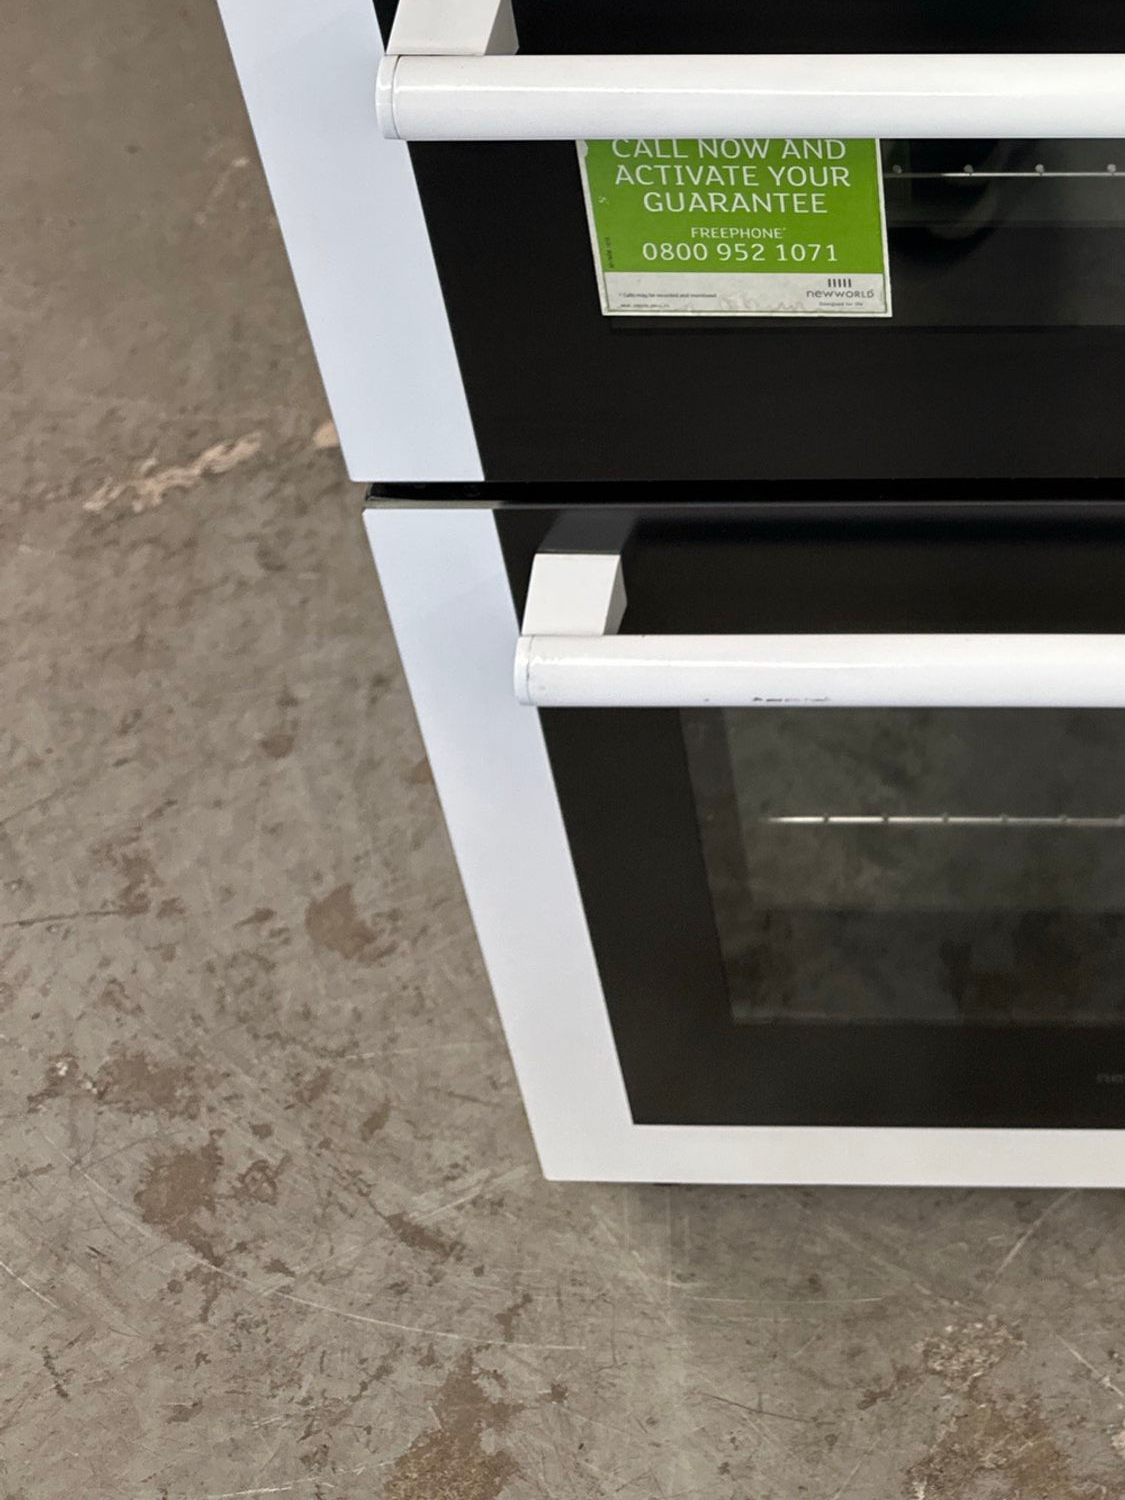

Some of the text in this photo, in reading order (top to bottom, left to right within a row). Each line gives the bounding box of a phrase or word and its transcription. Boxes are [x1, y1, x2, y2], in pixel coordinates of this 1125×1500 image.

[611, 138, 847, 160] CALL NOW AND
[614, 164, 851, 188] ACTIVATE YOUR
[643, 191, 828, 214] GUARANTEE
[641, 242, 838, 262] 0800 952 1071
